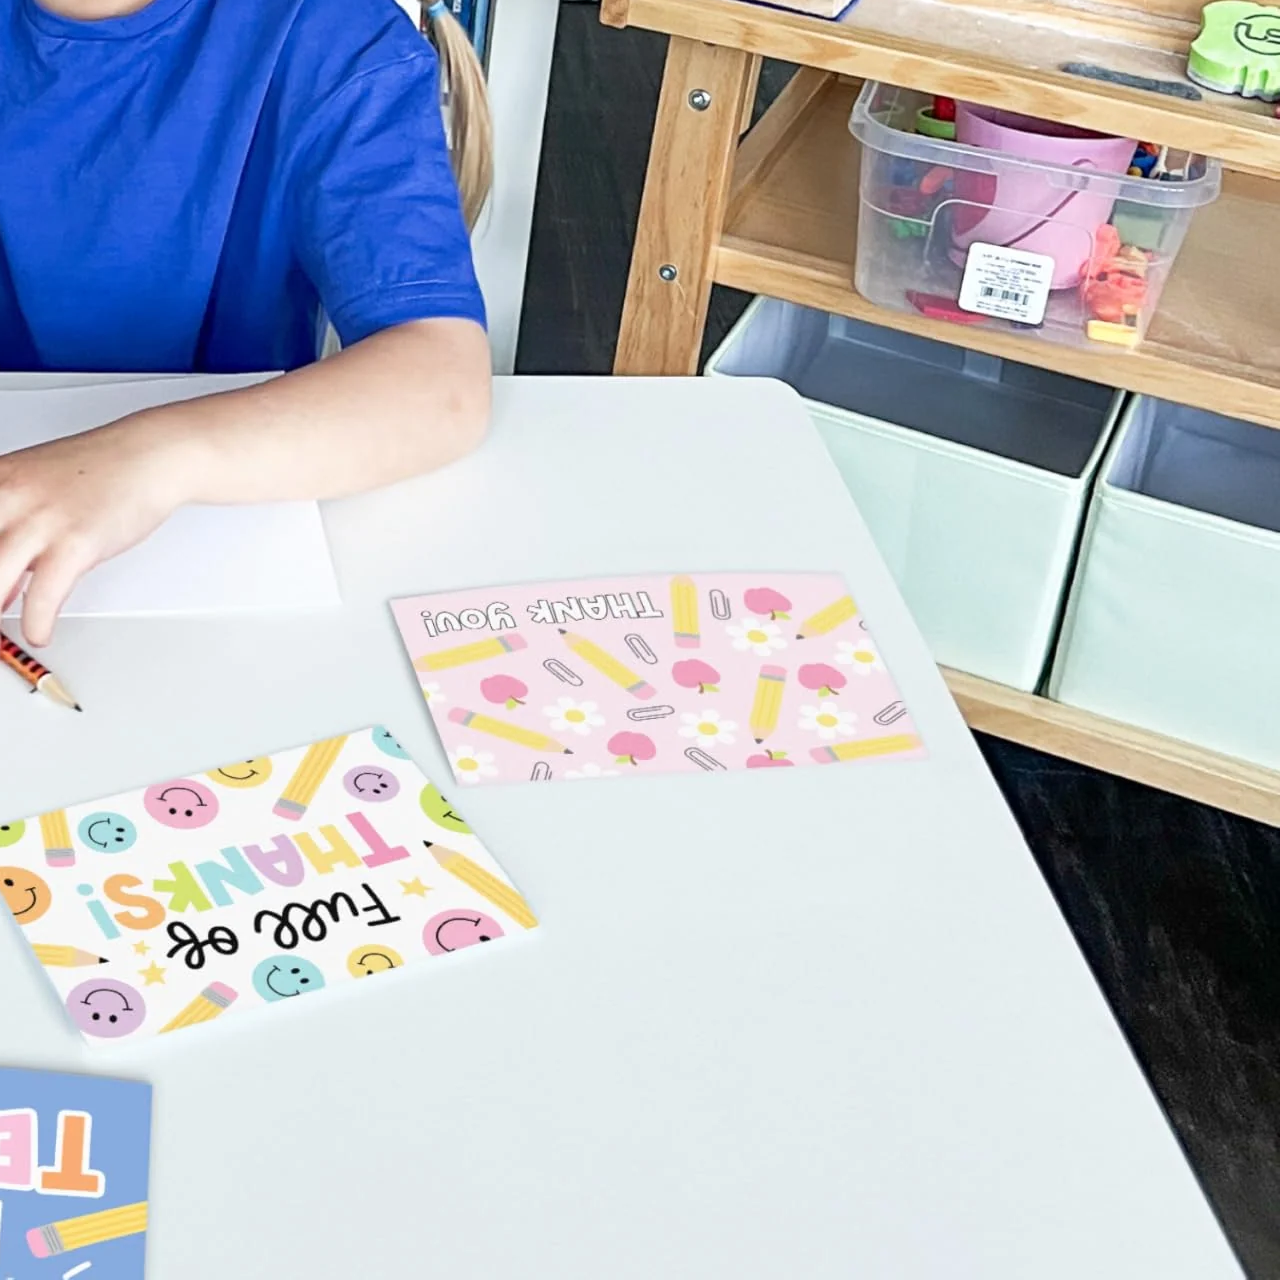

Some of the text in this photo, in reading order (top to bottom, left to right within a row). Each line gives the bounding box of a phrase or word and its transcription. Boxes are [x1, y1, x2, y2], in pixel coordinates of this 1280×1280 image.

[527, 591, 664, 625] THANK
[76, 811, 412, 941] THANKS!
[166, 882, 401, 970] Full of
